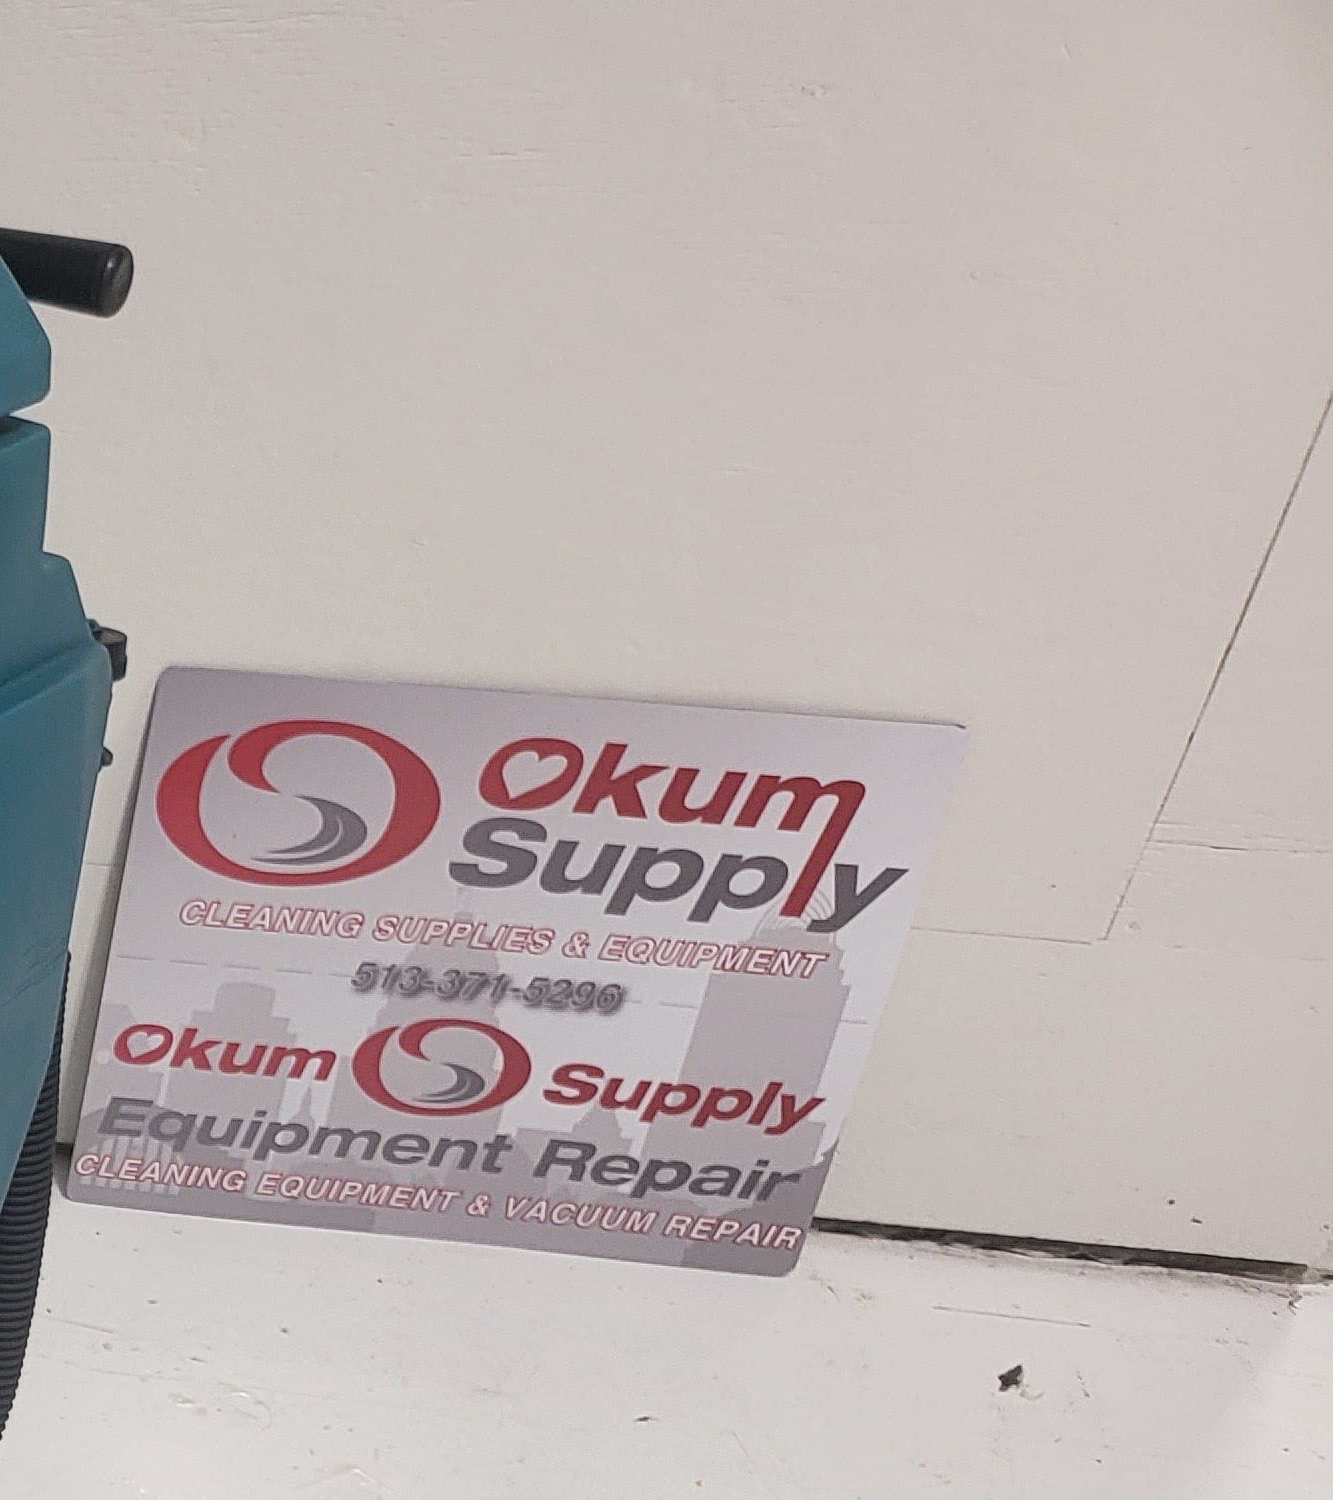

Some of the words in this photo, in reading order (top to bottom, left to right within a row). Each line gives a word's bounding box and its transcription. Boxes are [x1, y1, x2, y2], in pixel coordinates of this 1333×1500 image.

[476, 736, 867, 835] Okum
[447, 816, 909, 934] Supply
[179, 900, 363, 940] CLEANING
[371, 915, 555, 956] SUPPLIES
[561, 931, 591, 959] &
[598, 934, 830, 979] EQUIPMENT
[113, 1023, 337, 1081] Okum
[542, 1063, 825, 1135] Supply
[97, 1096, 513, 1174] Equipment
[533, 1137, 802, 1202] Repair
[74, 1153, 247, 1192] CLEANING
[255, 1173, 460, 1214] EQUIPMENT
[466, 1194, 491, 1217] &
[505, 1196, 656, 1235] VACUUM
[662, 1213, 803, 1251] REPAIR
